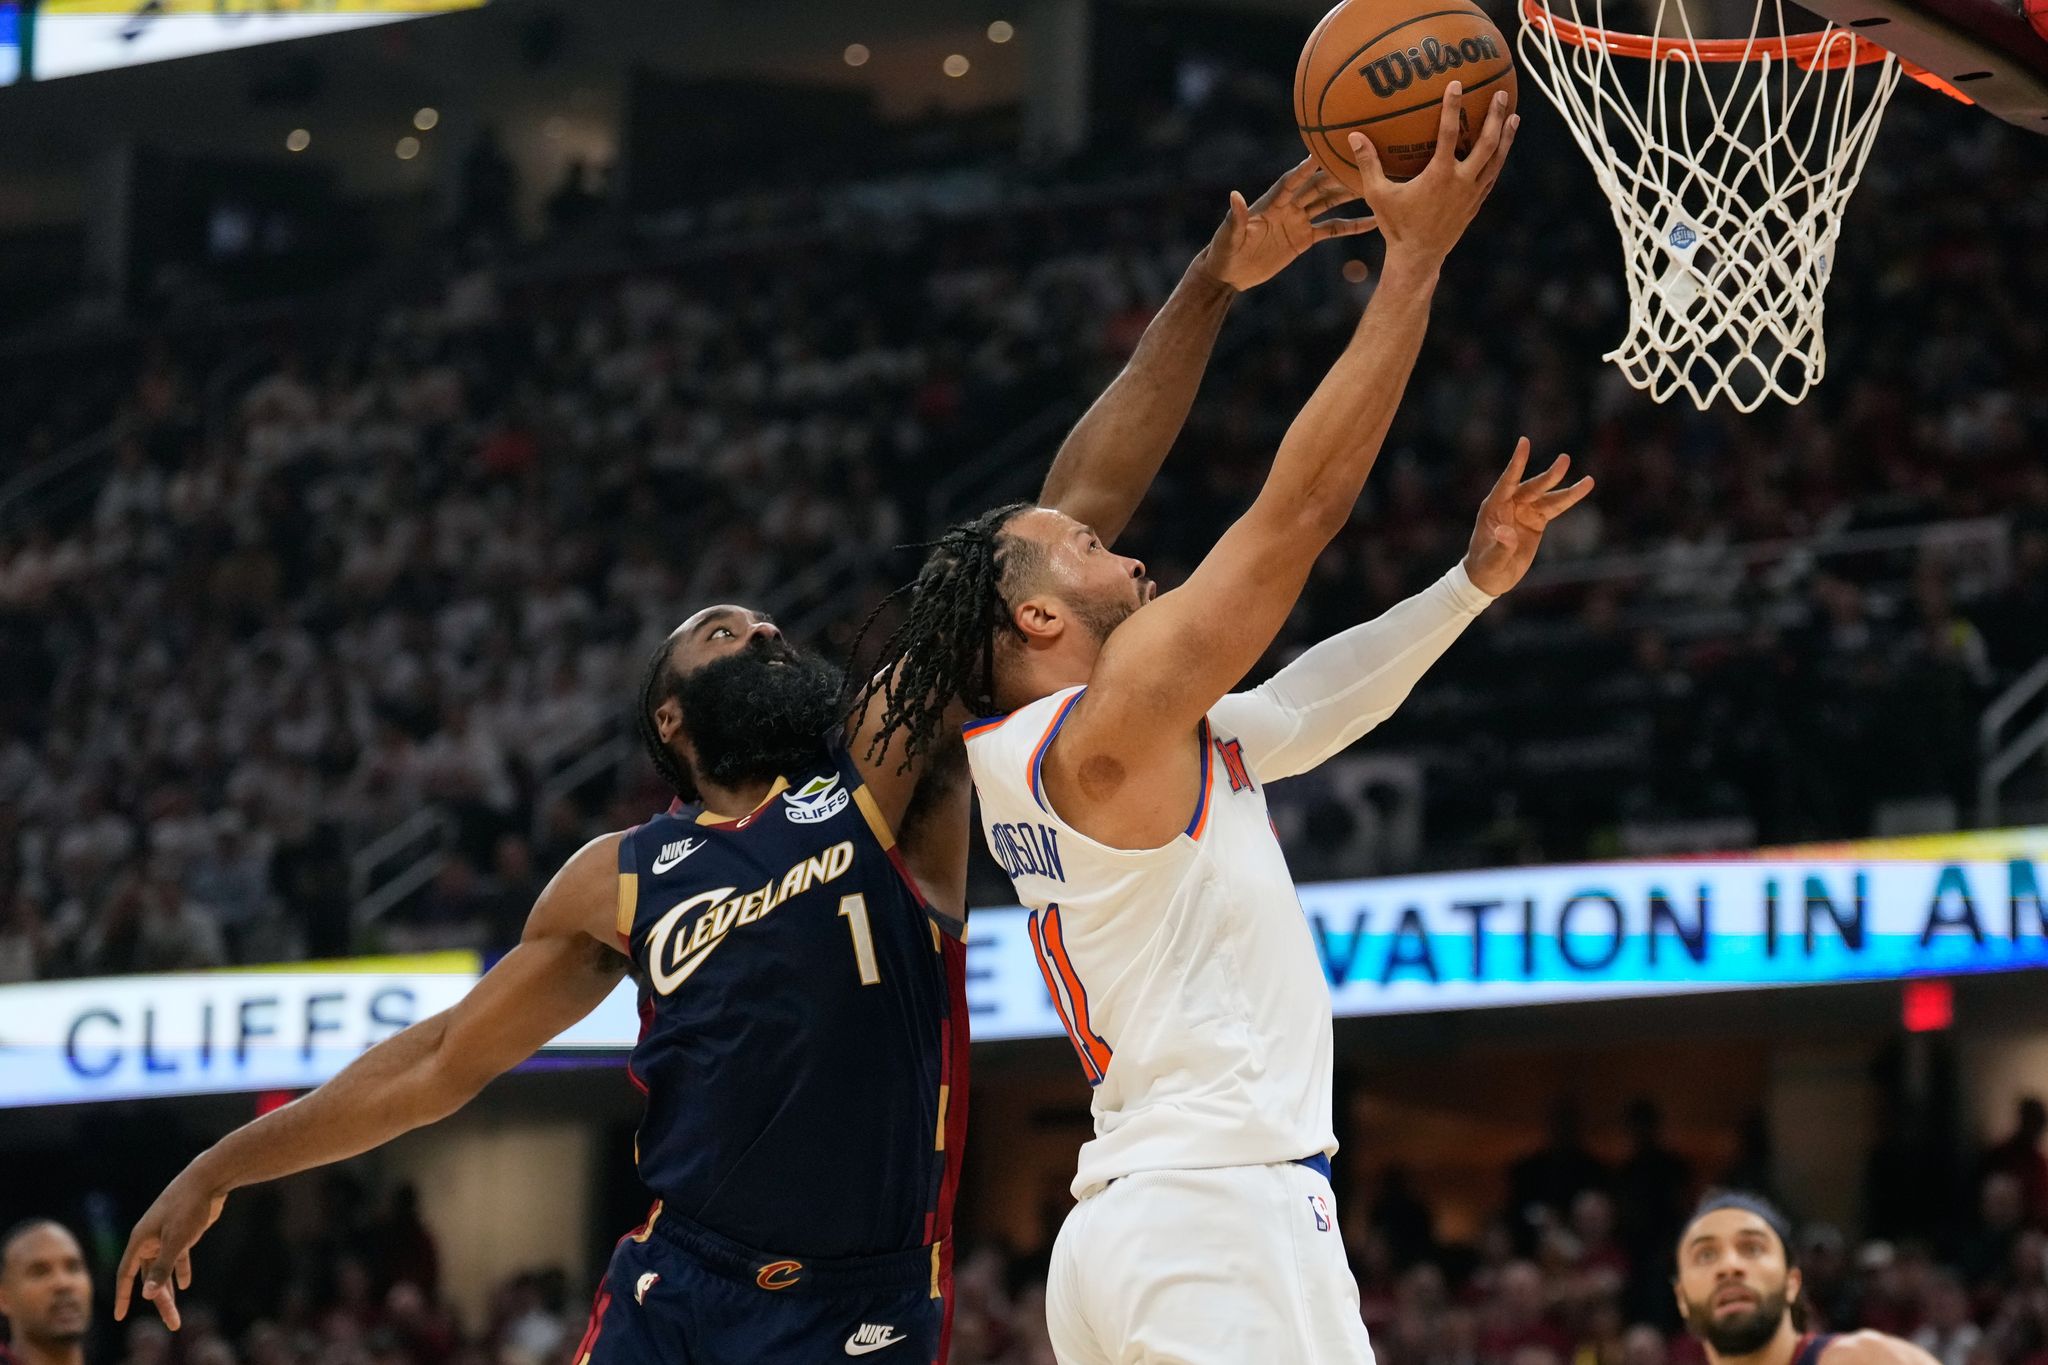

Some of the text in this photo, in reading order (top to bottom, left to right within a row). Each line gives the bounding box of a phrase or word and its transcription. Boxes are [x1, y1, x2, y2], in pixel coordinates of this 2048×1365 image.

[1358, 35, 1500, 99] Wilson
[788, 791, 847, 820] CLIFFS
[660, 837, 693, 862] NIKE
[837, 892, 881, 986] 1
[1765, 869, 1867, 957] IN
[65, 985, 416, 1078] CLIFFS
[1027, 902, 1113, 1087] 11
[854, 1323, 894, 1345] NIKE
